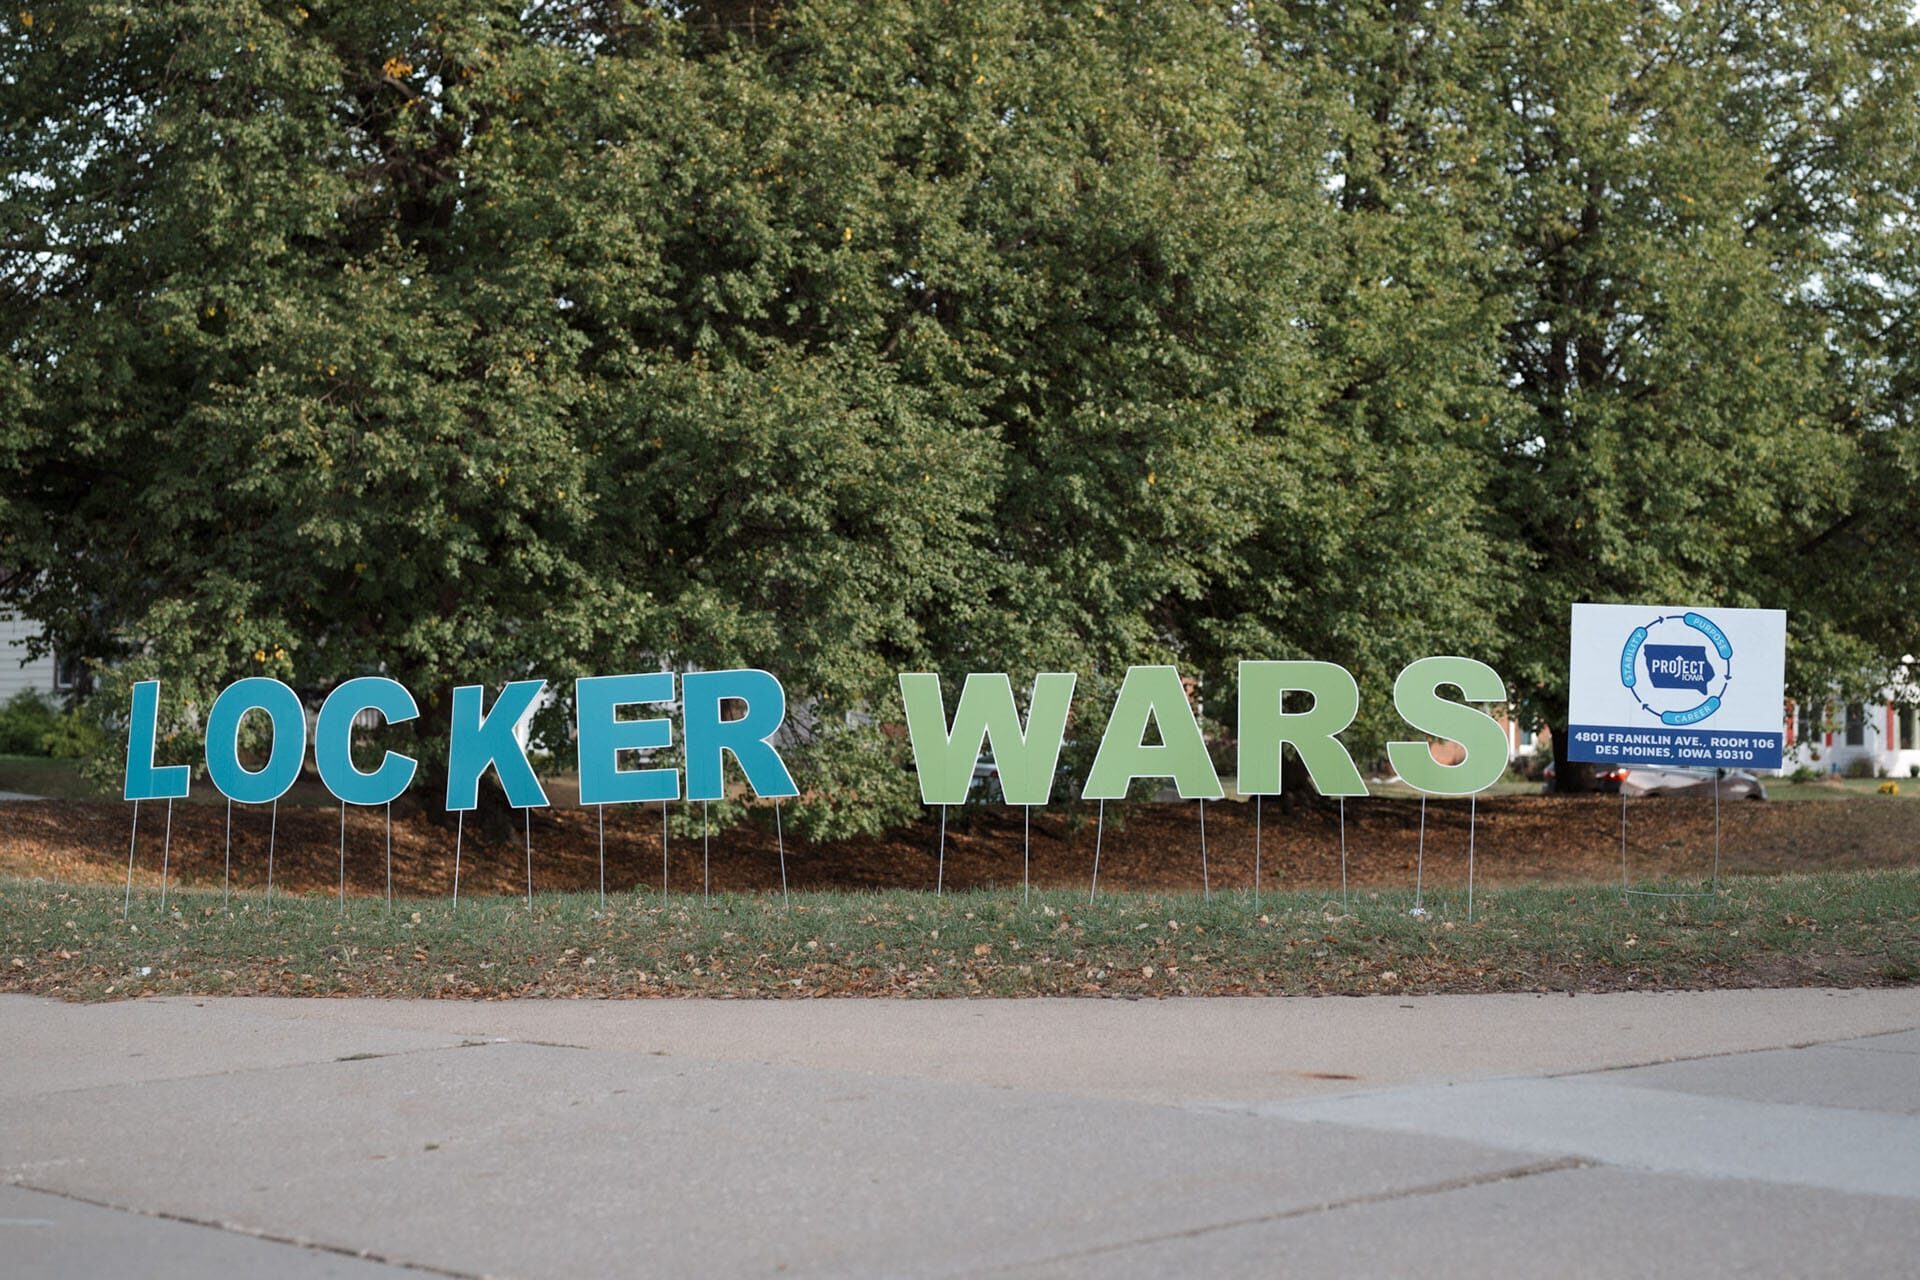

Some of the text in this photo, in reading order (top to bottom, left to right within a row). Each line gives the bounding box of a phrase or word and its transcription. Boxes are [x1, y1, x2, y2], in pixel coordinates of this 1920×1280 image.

[1692, 617, 1728, 651] PURPOSE
[1624, 631, 1643, 681] STABILITY
[1651, 656, 1705, 678] PROJECT
[1681, 674, 1705, 682] IOWA
[1673, 704, 1713, 723] CAREER
[124, 656, 1510, 811] LOCKER WARS
[1574, 732, 1775, 749] 4801 FRANKLIN AVE., ROOM 106
[1595, 745, 1754, 760] DES MOINES, IOWA 50310
